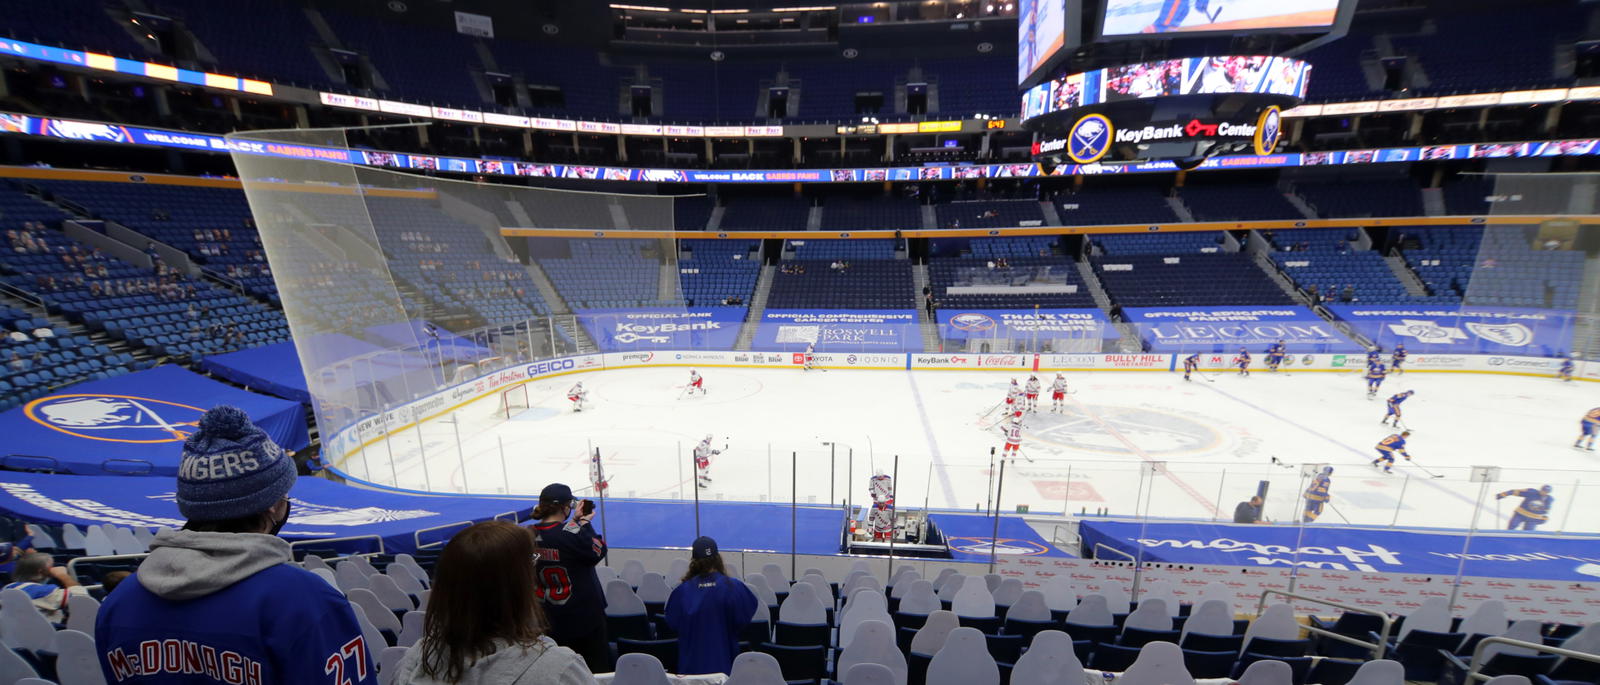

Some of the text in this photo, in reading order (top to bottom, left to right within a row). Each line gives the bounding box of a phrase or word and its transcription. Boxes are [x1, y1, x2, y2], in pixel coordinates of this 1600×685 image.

[144, 132, 207, 146] WELCOME
[208, 136, 265, 153] BACK
[1115, 122, 1257, 144] KeyBank Center
[1040, 137, 1067, 153] Center
[1136, 161, 1178, 170] WELCOM
[616, 321, 720, 334] KeyBank
[527, 359, 574, 376] GEICO
[1136, 538, 1403, 566] Hortons
[107, 638, 262, 685] McDONAGH
[324, 635, 367, 685] 27
